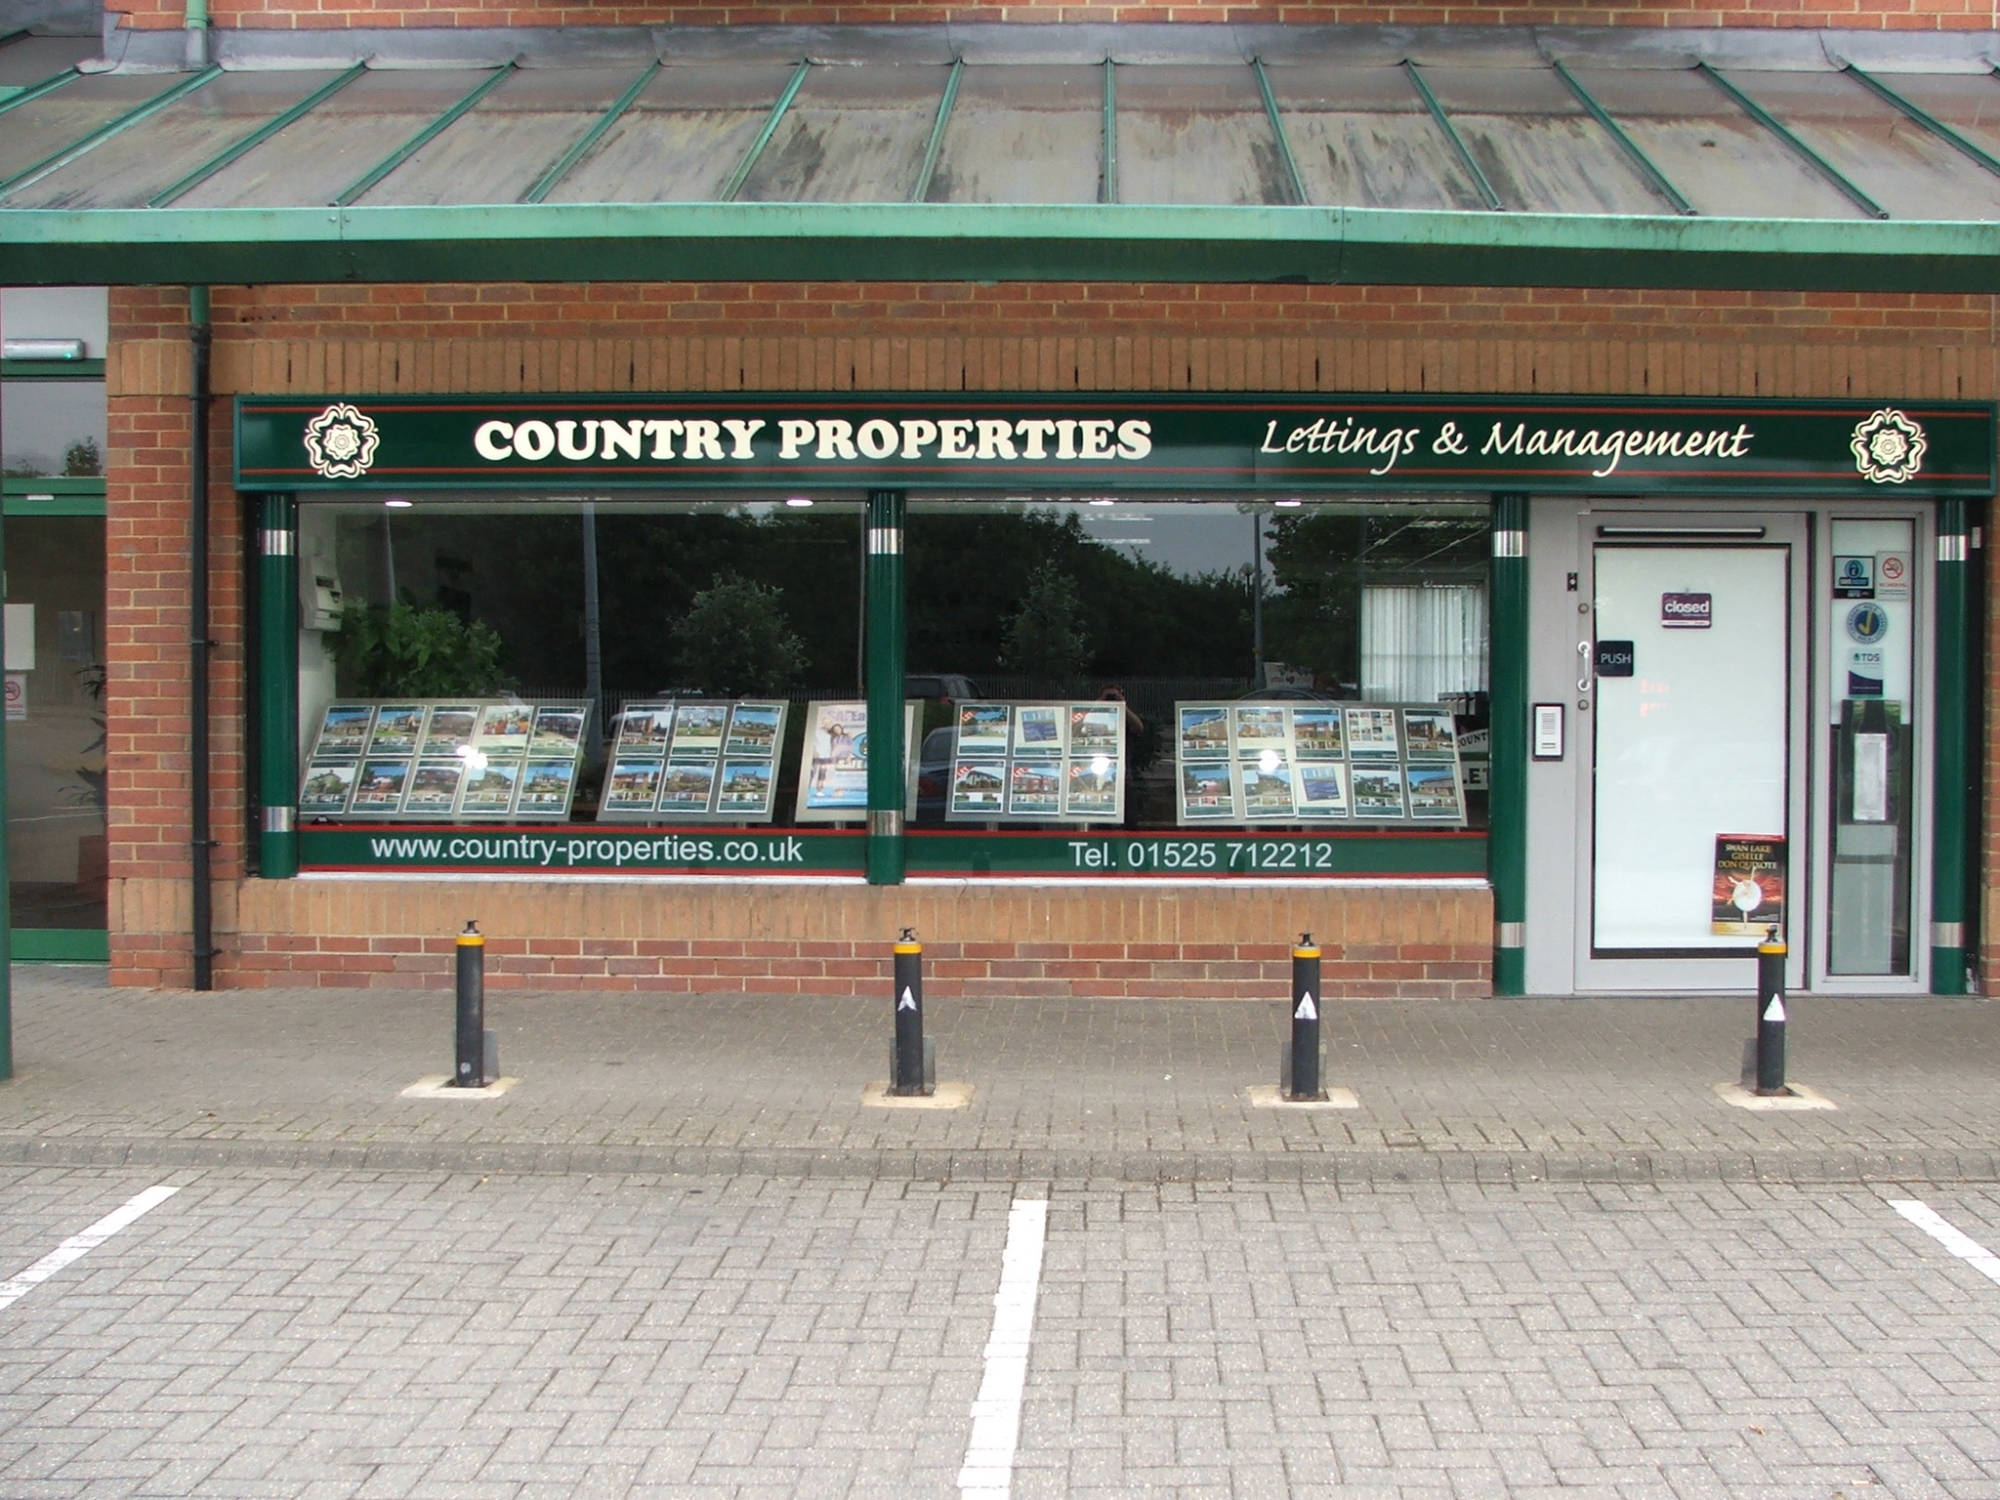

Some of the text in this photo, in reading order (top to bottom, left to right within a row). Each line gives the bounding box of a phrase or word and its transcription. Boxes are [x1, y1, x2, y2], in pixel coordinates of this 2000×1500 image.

[474, 419, 1152, 461] COUNTRY PROPERTIES
[1260, 417, 1754, 478] Lettings & Management
[1664, 600, 1710, 613] closed
[1600, 653, 1632, 664] PUSH
[371, 834, 803, 867] www.country-properties.co.uk
[1068, 841, 1332, 868] Tel. 01525 712212
[1731, 853, 1764, 861] GISELLE
[1718, 860, 1737, 868] DON
